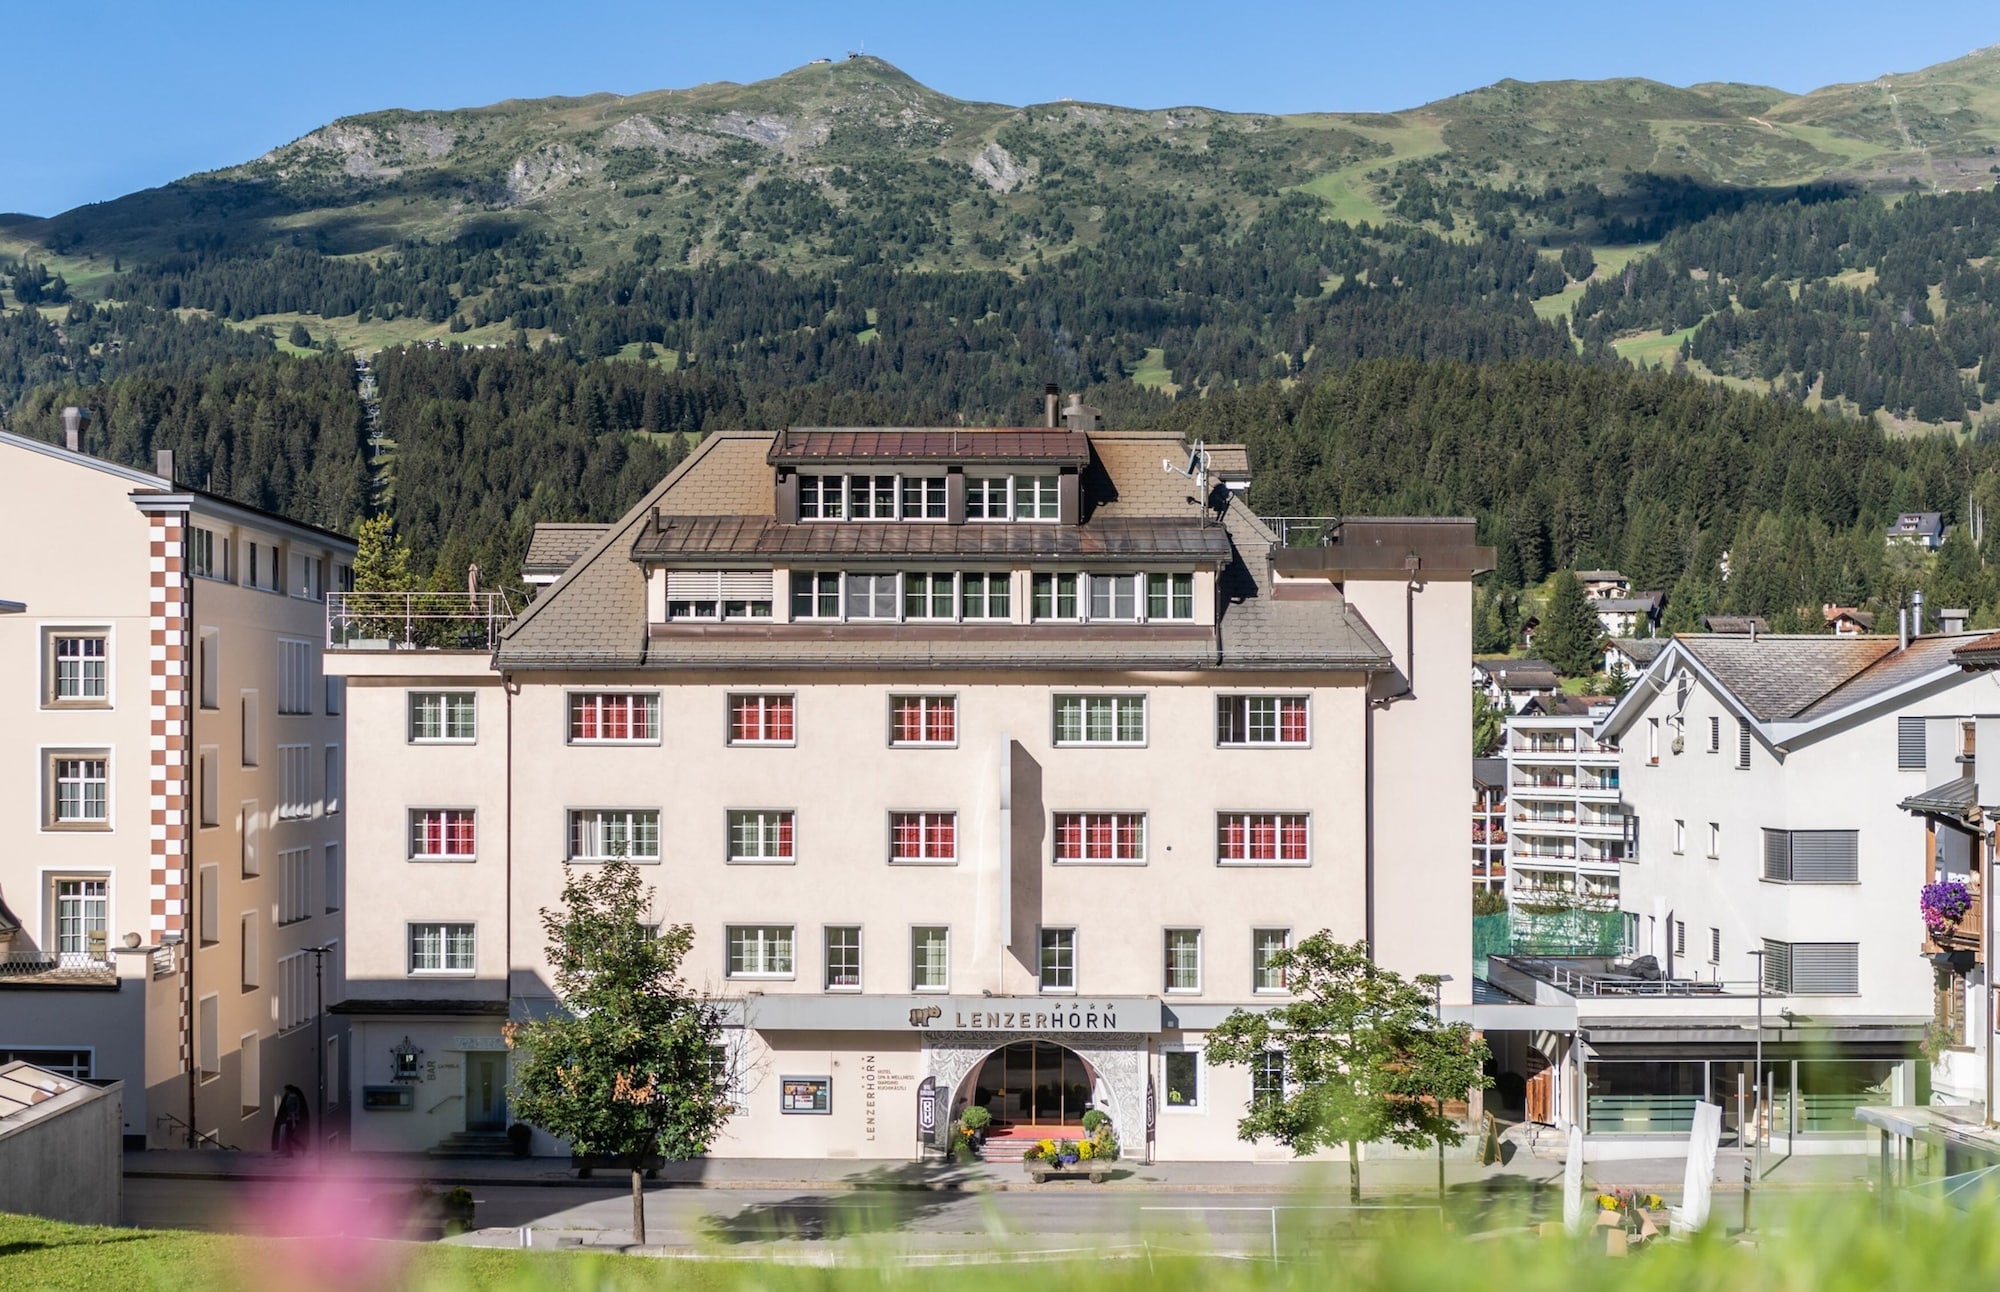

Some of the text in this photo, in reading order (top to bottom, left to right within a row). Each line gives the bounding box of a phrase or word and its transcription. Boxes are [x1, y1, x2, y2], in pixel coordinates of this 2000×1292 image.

[955, 1012, 1116, 1029] LENZERHORN
[427, 1060, 436, 1080] BAR
[866, 1055, 875, 1142] LENZERHORN
